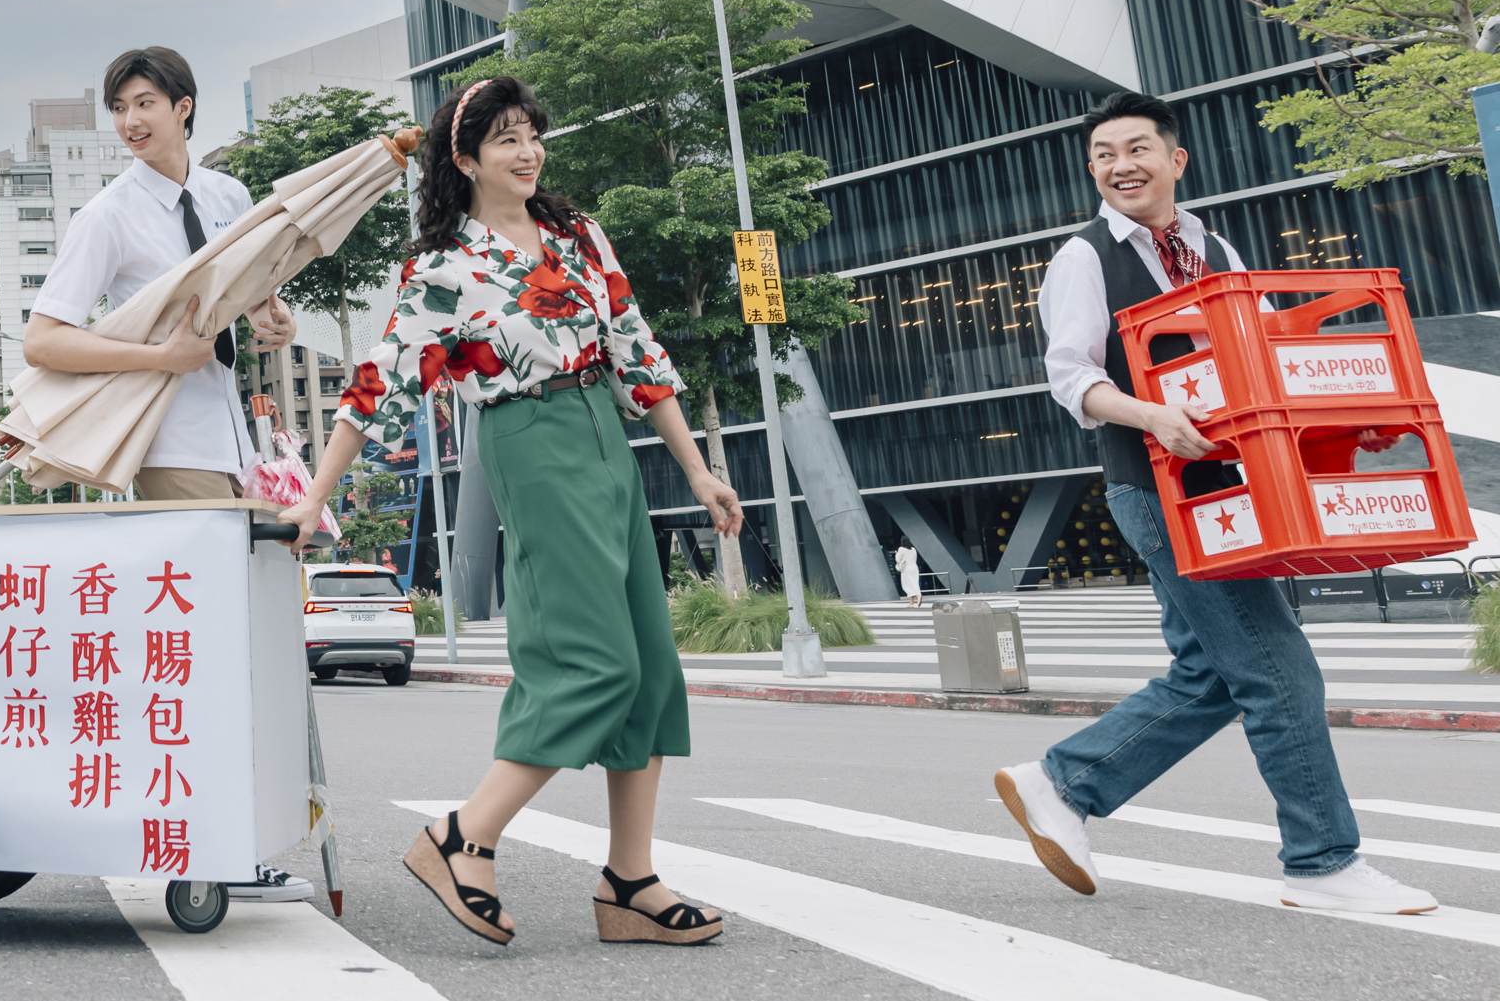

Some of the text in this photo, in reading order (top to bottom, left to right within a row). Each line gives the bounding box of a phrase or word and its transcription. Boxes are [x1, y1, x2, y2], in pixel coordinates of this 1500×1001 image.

[736, 232, 763, 322] 科技執法
[757, 232, 785, 322] 前方路口實施
[1204, 363, 1215, 376] 20
[1304, 357, 1387, 378] SAPPORO
[1240, 498, 1251, 511] 20
[1341, 493, 1428, 516] SAPPORO
[1220, 538, 1245, 550] SAPPORO
[68, 562, 122, 809] 香酥雞排
[140, 560, 195, 876] 大腸包小腸
